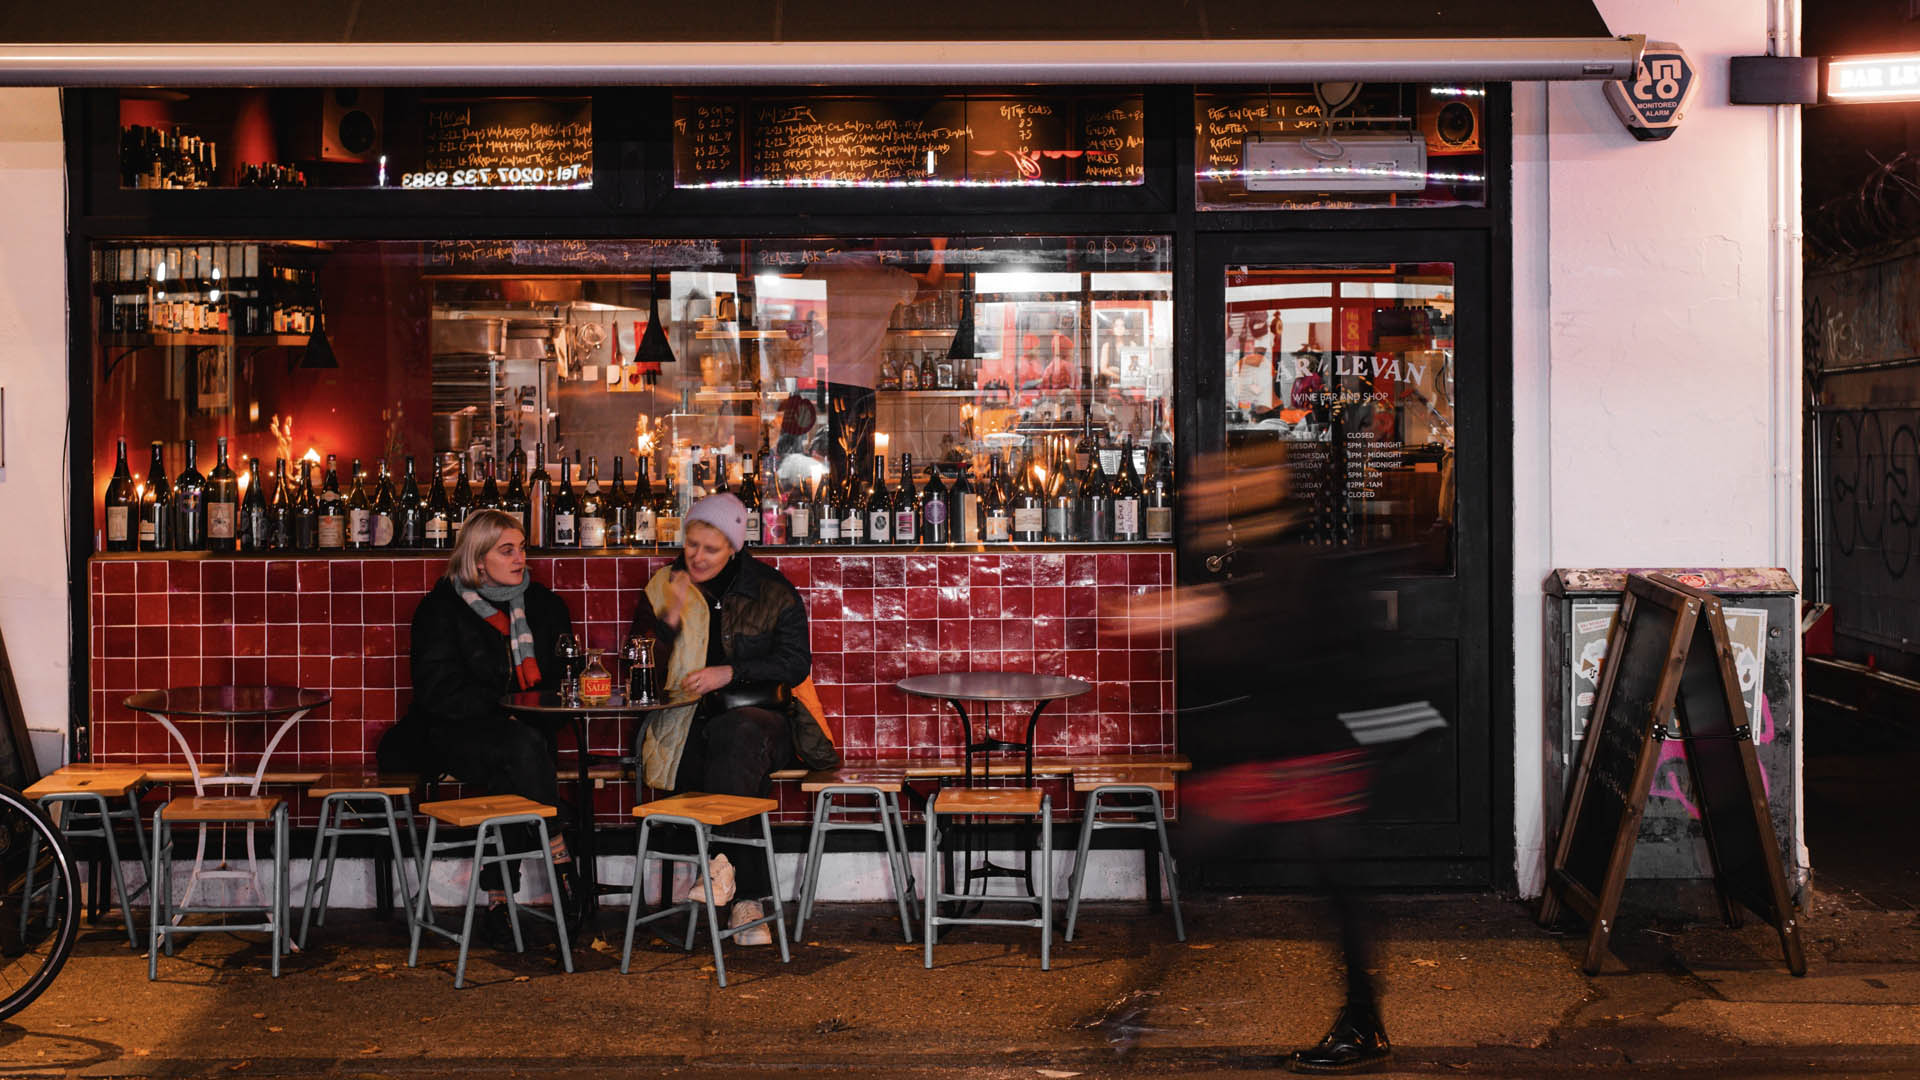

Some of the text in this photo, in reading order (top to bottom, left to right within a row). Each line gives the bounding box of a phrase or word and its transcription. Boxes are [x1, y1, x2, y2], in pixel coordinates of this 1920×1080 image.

[1840, 65, 1920, 88] BAR LE
[1276, 357, 1314, 384] AR
[1335, 355, 1427, 385] LEVAN
[1292, 392, 1389, 403] WINE BAR AND SHOP
